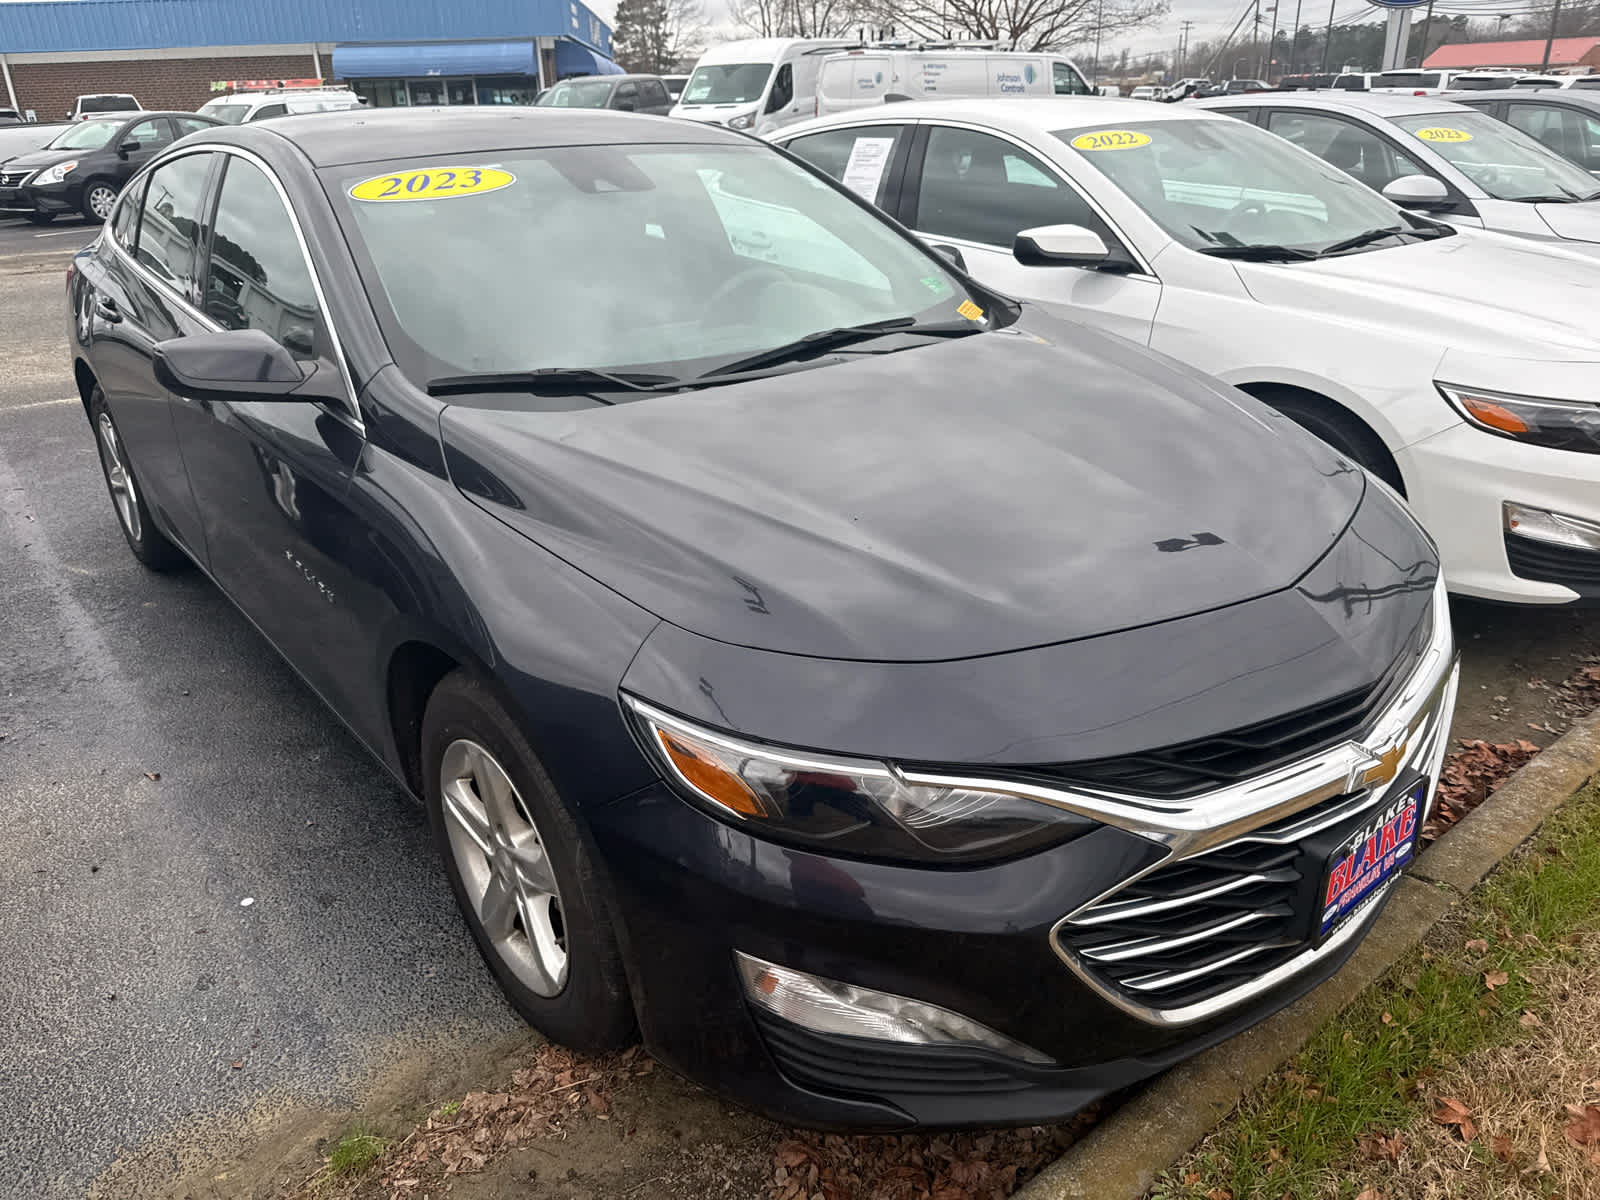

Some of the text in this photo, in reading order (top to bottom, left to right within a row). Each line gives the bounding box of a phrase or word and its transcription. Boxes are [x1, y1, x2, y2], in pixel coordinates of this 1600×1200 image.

[996, 72, 1021, 83] Johnson
[1086, 132, 1138, 149] 2022
[378, 169, 483, 198] 2023
[1353, 793, 1408, 849] BLAKE
[1325, 803, 1417, 908] BLAKE
